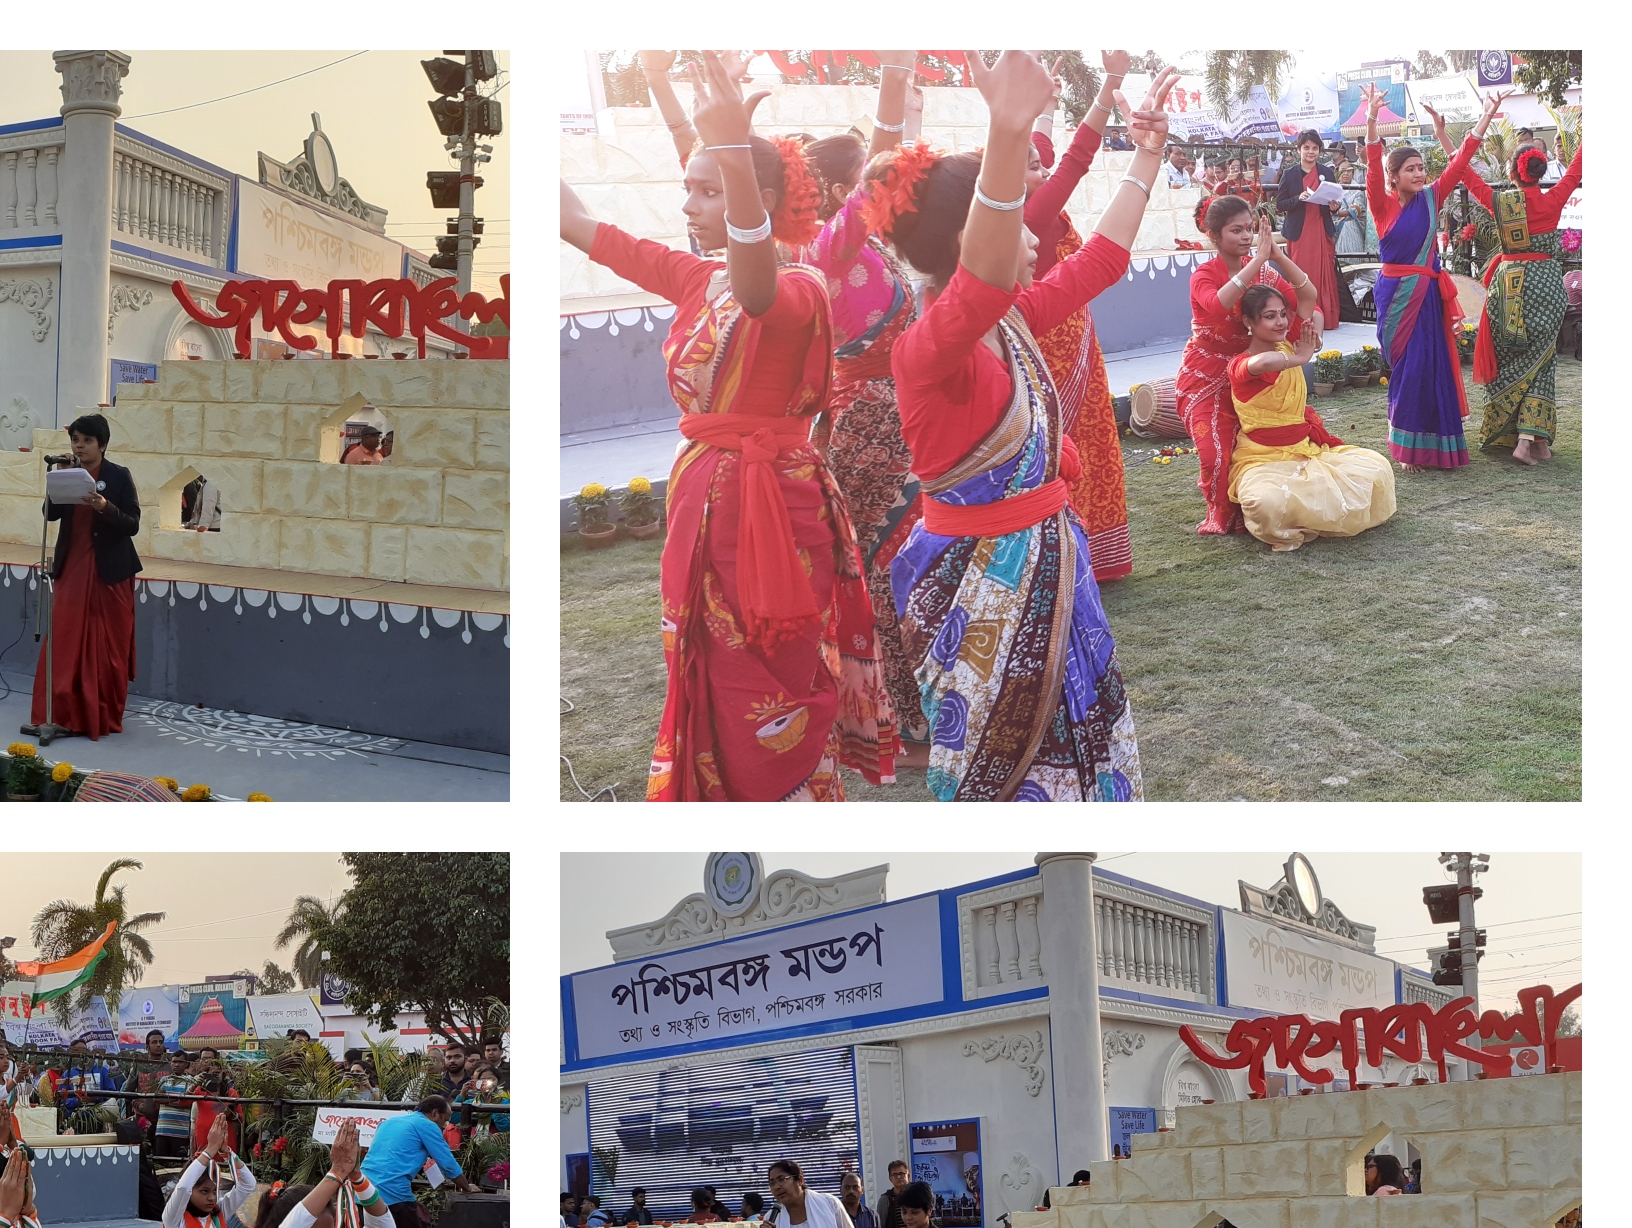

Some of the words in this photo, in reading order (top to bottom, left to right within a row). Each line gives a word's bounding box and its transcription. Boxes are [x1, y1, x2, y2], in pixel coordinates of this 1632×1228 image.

[120, 364, 132, 373] Save
[133, 365, 148, 375] Water
[122, 373, 135, 383] Save
[611, 954, 770, 1014] পশ্চিমবঙ্গ
[619, 1027, 643, 1042] তথ্য
[650, 1026, 660, 1038] ও
[668, 1011, 710, 1039] সংস্কৃতি
[718, 1006, 760, 1028] বিভাগ,
[766, 993, 826, 1018] পশ্চিমবঙ্গ
[834, 981, 883, 1005] সরকার
[1118, 1111, 1130, 1119] Save
[1132, 1111, 1146, 1119] Water
[1121, 1120, 1134, 1129] Save
[1135, 1120, 1144, 1129] Life
